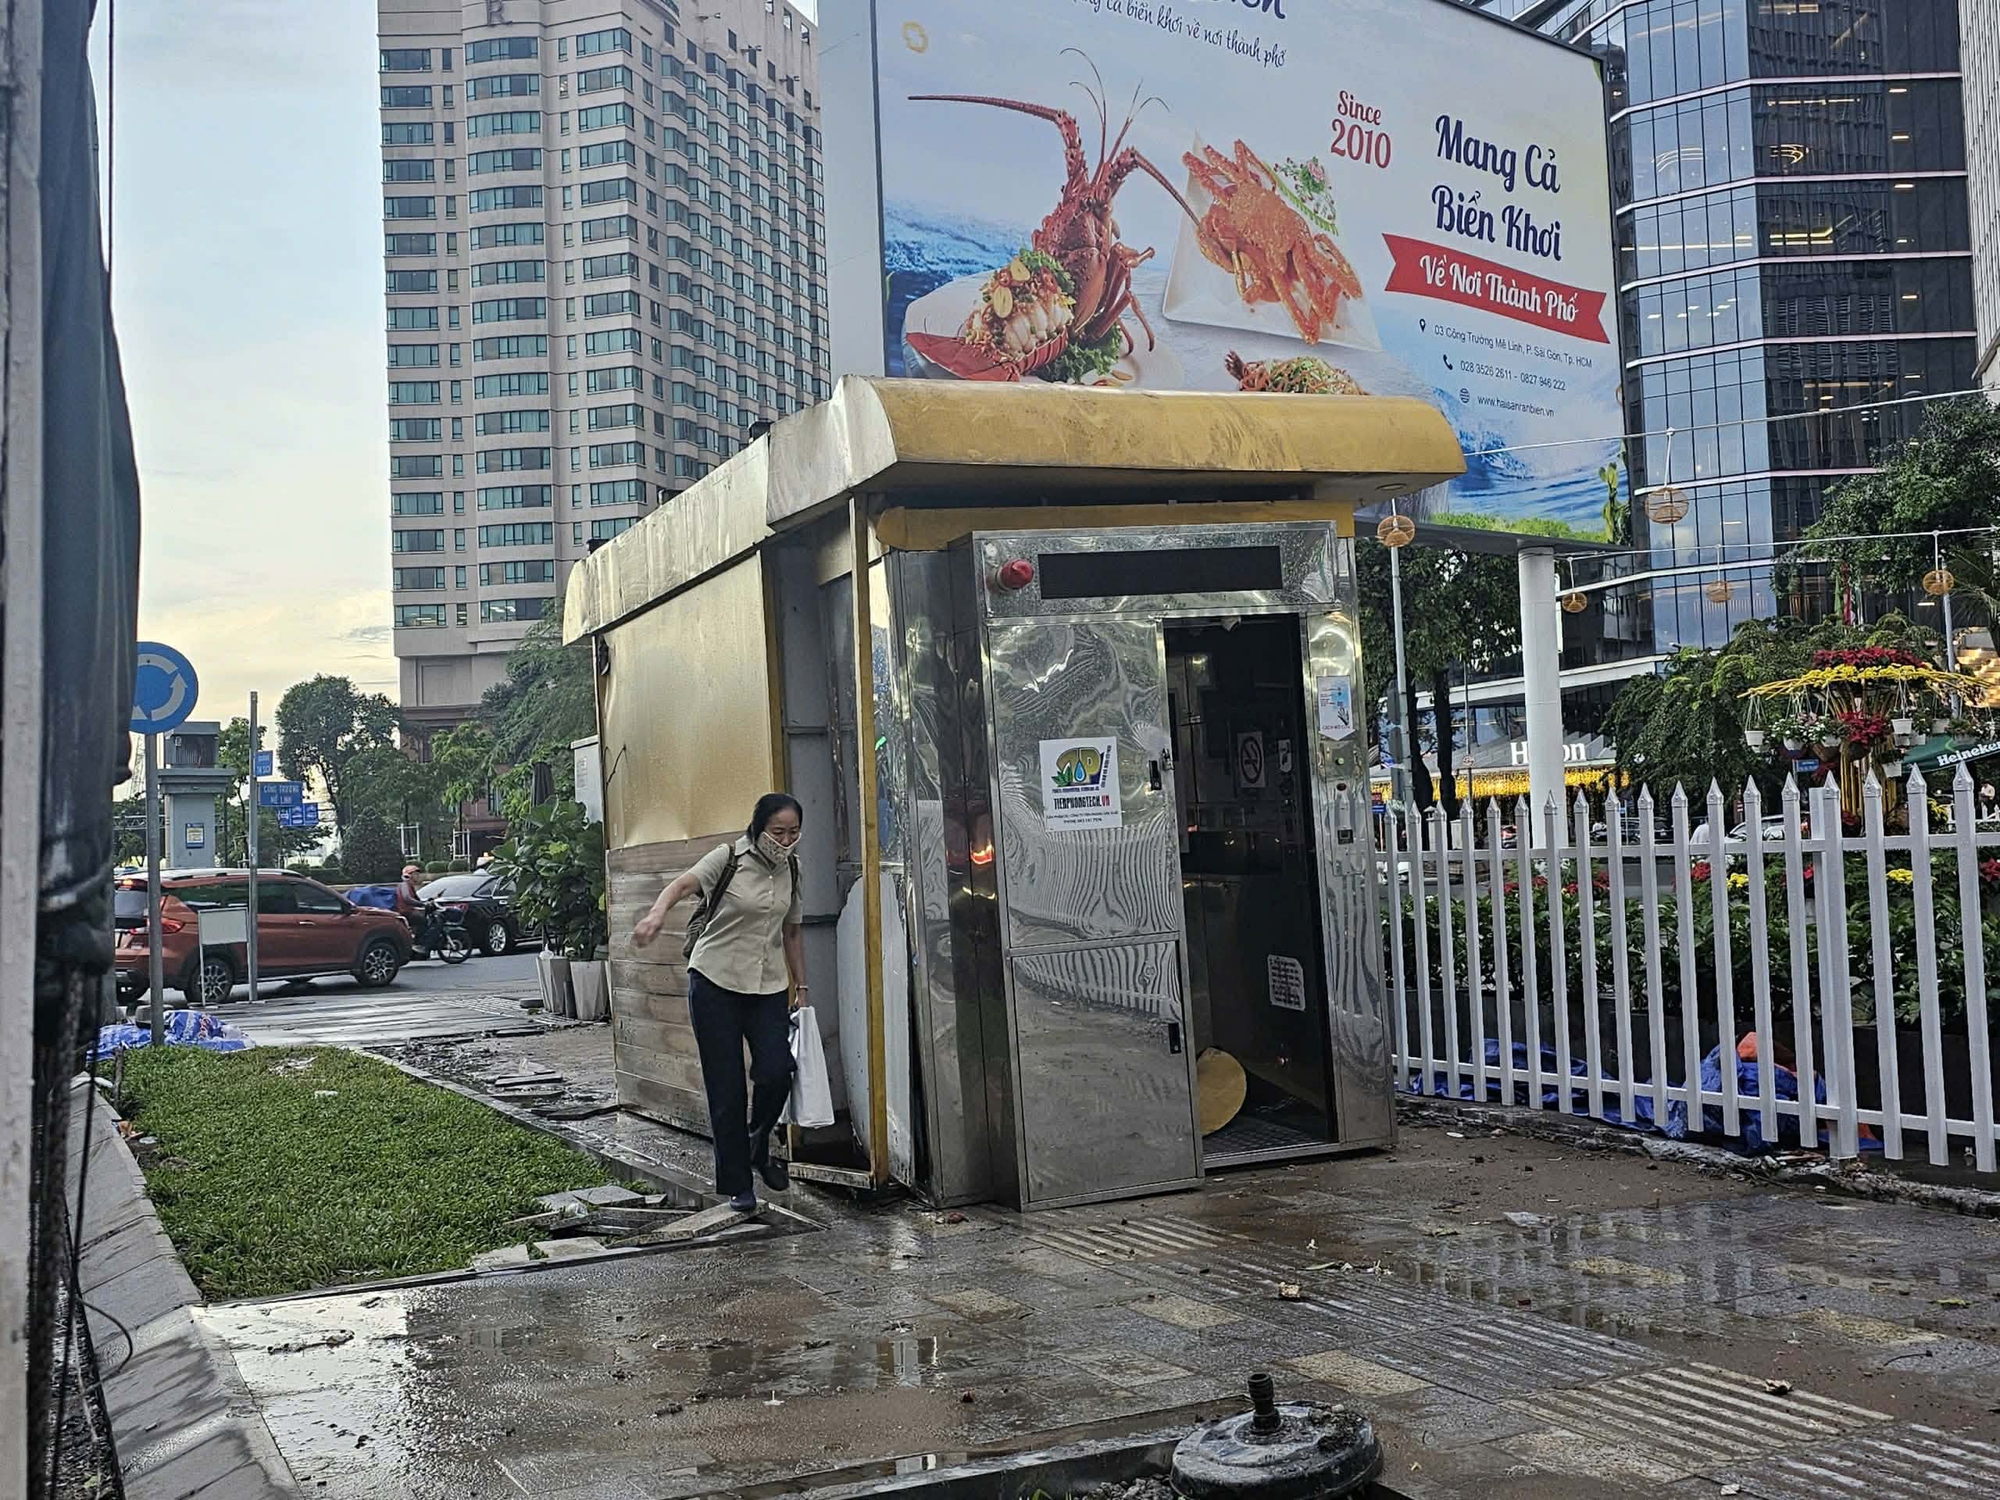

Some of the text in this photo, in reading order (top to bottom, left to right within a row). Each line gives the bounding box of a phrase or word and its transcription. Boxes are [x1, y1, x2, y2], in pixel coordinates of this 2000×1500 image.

[1157, 5, 1182, 33] khơi
[1187, 19, 1201, 39] về
[1204, 29, 1222, 46] nơi
[1226, 29, 1260, 61] thành
[1264, 43, 1287, 68] phố
[1338, 90, 1382, 126] Since
[1331, 118, 1391, 169] 2010
[1436, 115, 1561, 193] Mang Cả
[1432, 185, 1561, 261] Biển Khơi
[1420, 254, 1578, 323] Về Nơi Thành Phố
[1434, 324, 1444, 336] 03
[1526, 344, 1533, 355] P.
[1576, 355, 1592, 368] HCM
[1460, 360, 1474, 373] 028
[1552, 379, 1566, 391] 222
